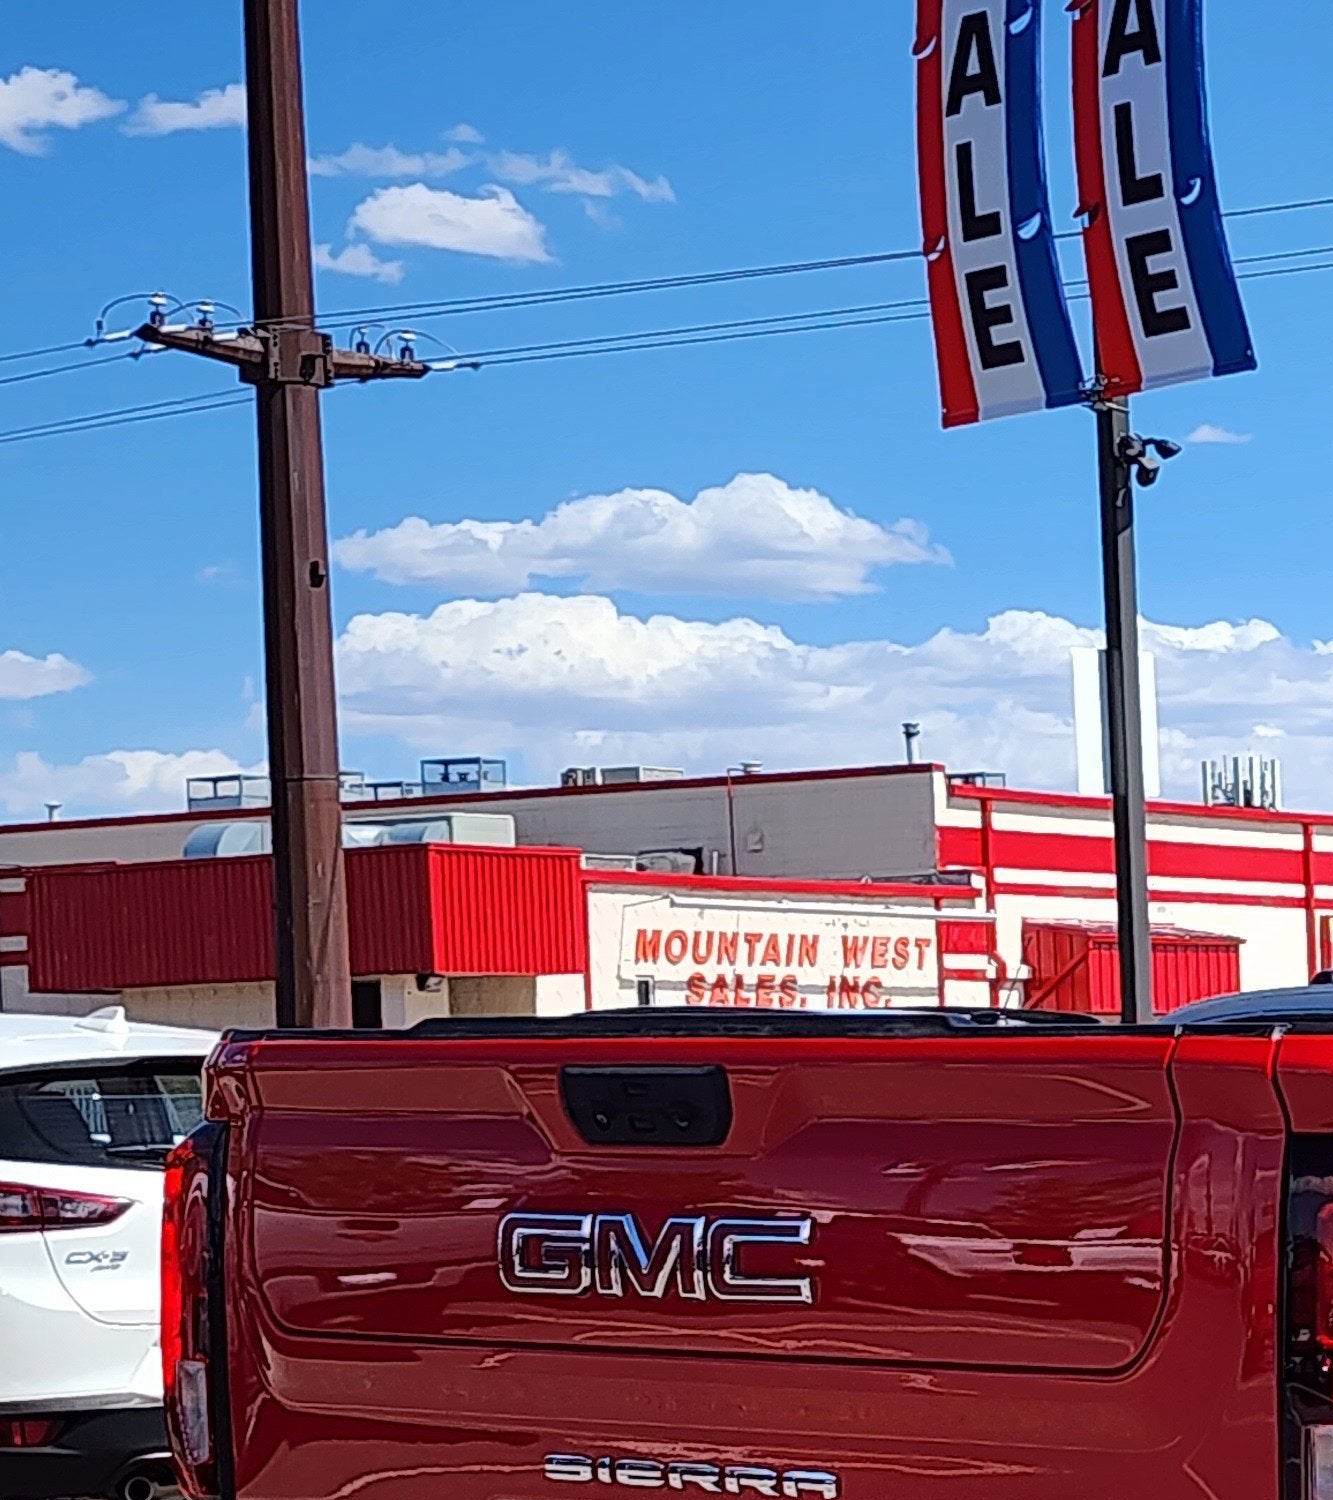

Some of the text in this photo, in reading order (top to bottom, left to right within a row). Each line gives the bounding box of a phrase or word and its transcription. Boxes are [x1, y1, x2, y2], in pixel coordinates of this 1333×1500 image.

[945, 10, 1025, 371] ALE
[634, 928, 932, 970] MOUNTAIN WEST
[498, 1212, 813, 1305] GMC
[542, 1453, 839, 1500] SIERRA
